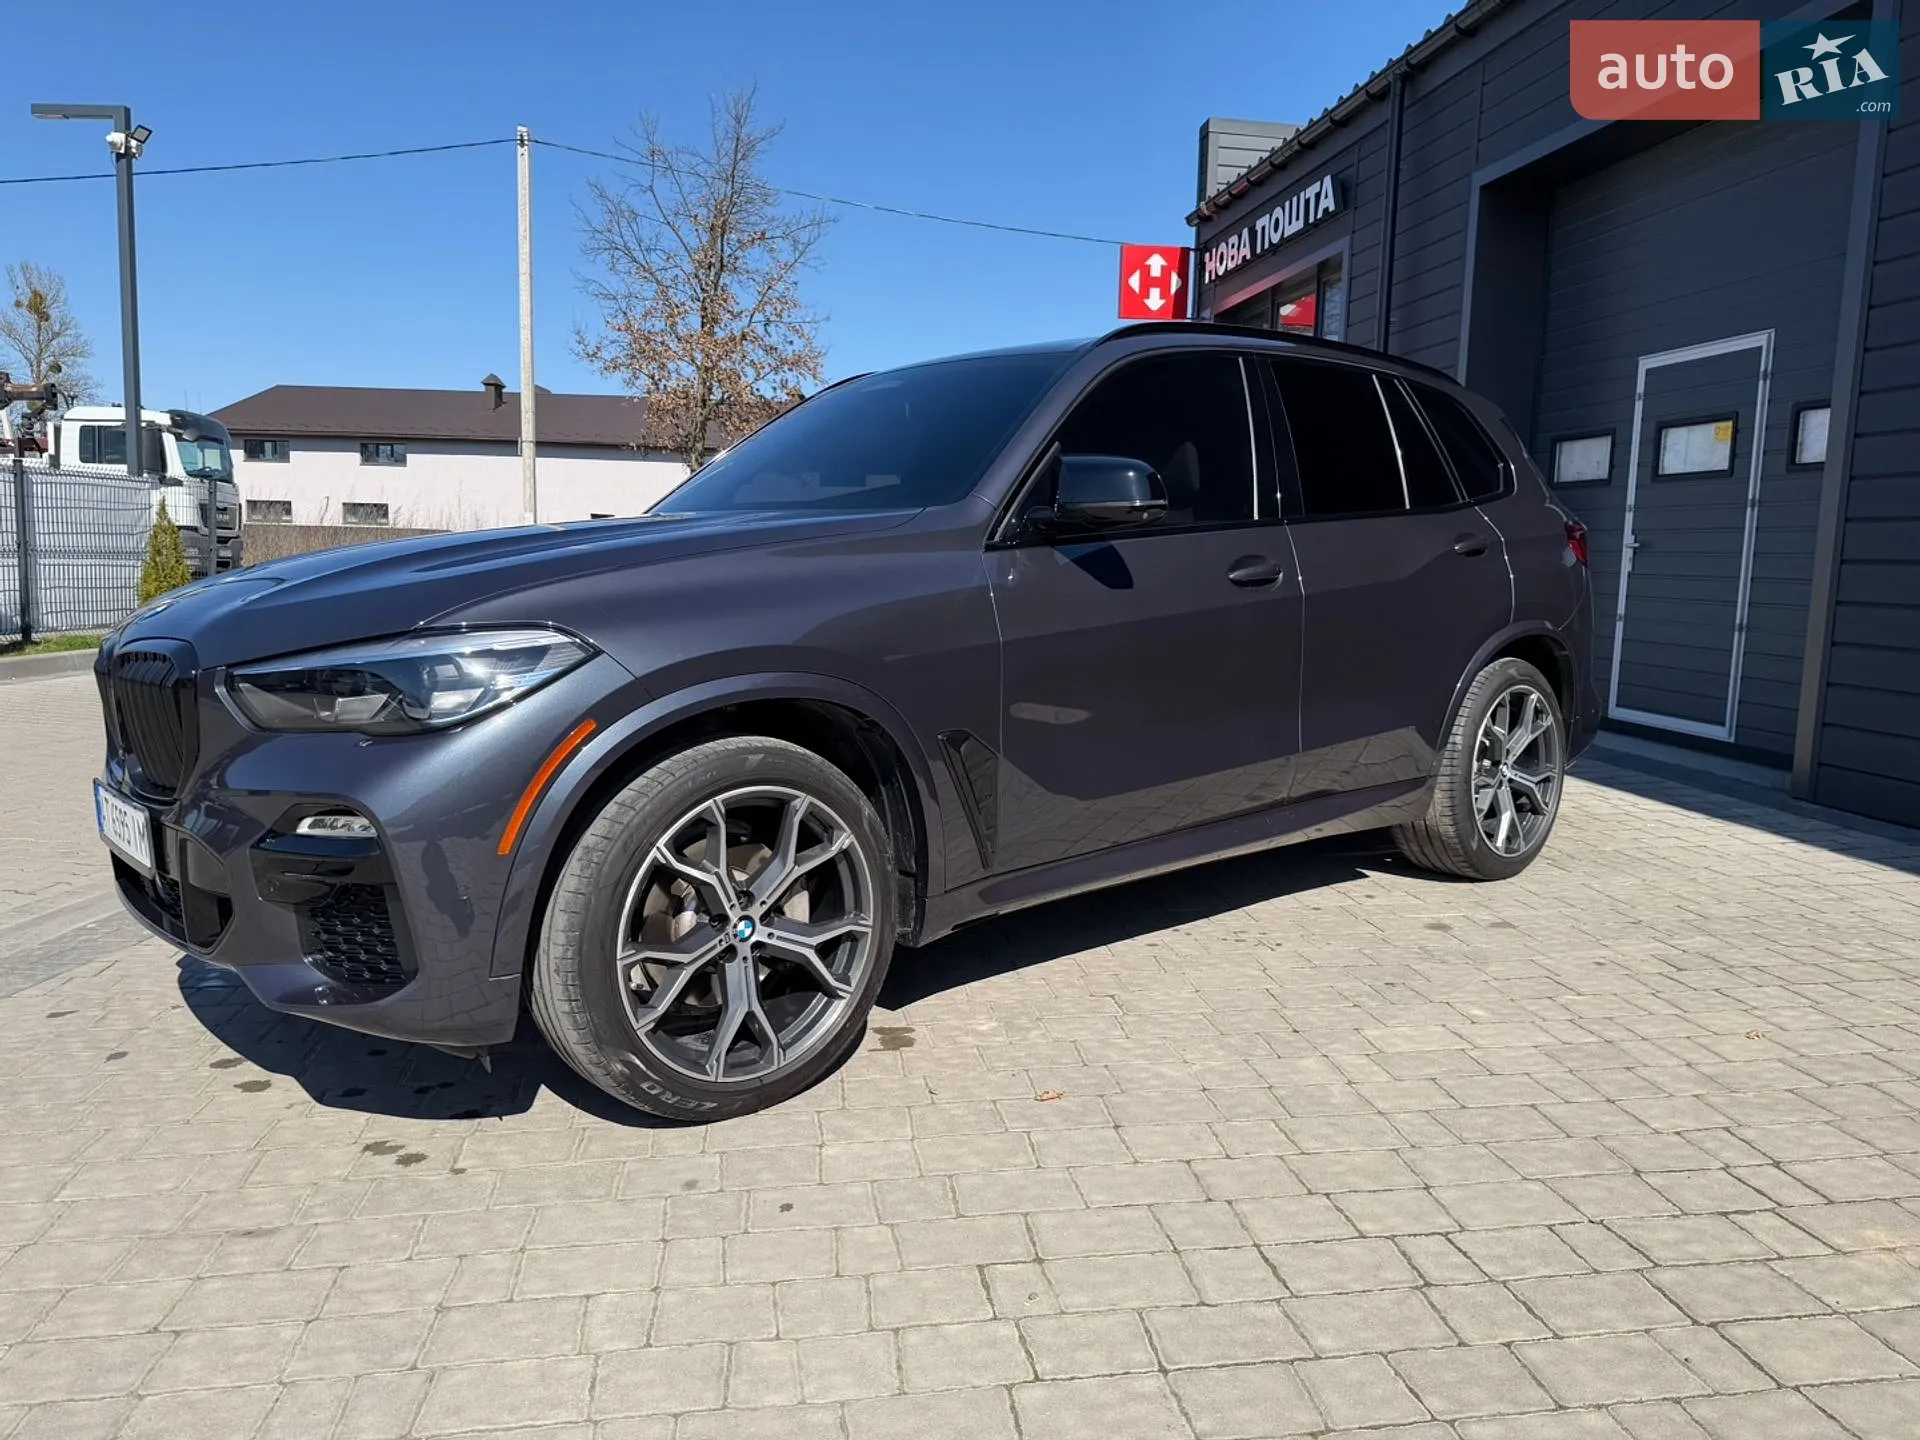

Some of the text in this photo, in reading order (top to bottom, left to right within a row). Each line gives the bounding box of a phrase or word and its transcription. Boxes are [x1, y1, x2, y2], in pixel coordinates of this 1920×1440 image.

[1204, 175, 1335, 285] НОВА ПОШТА
[640, 1081, 719, 1112] ZERO
